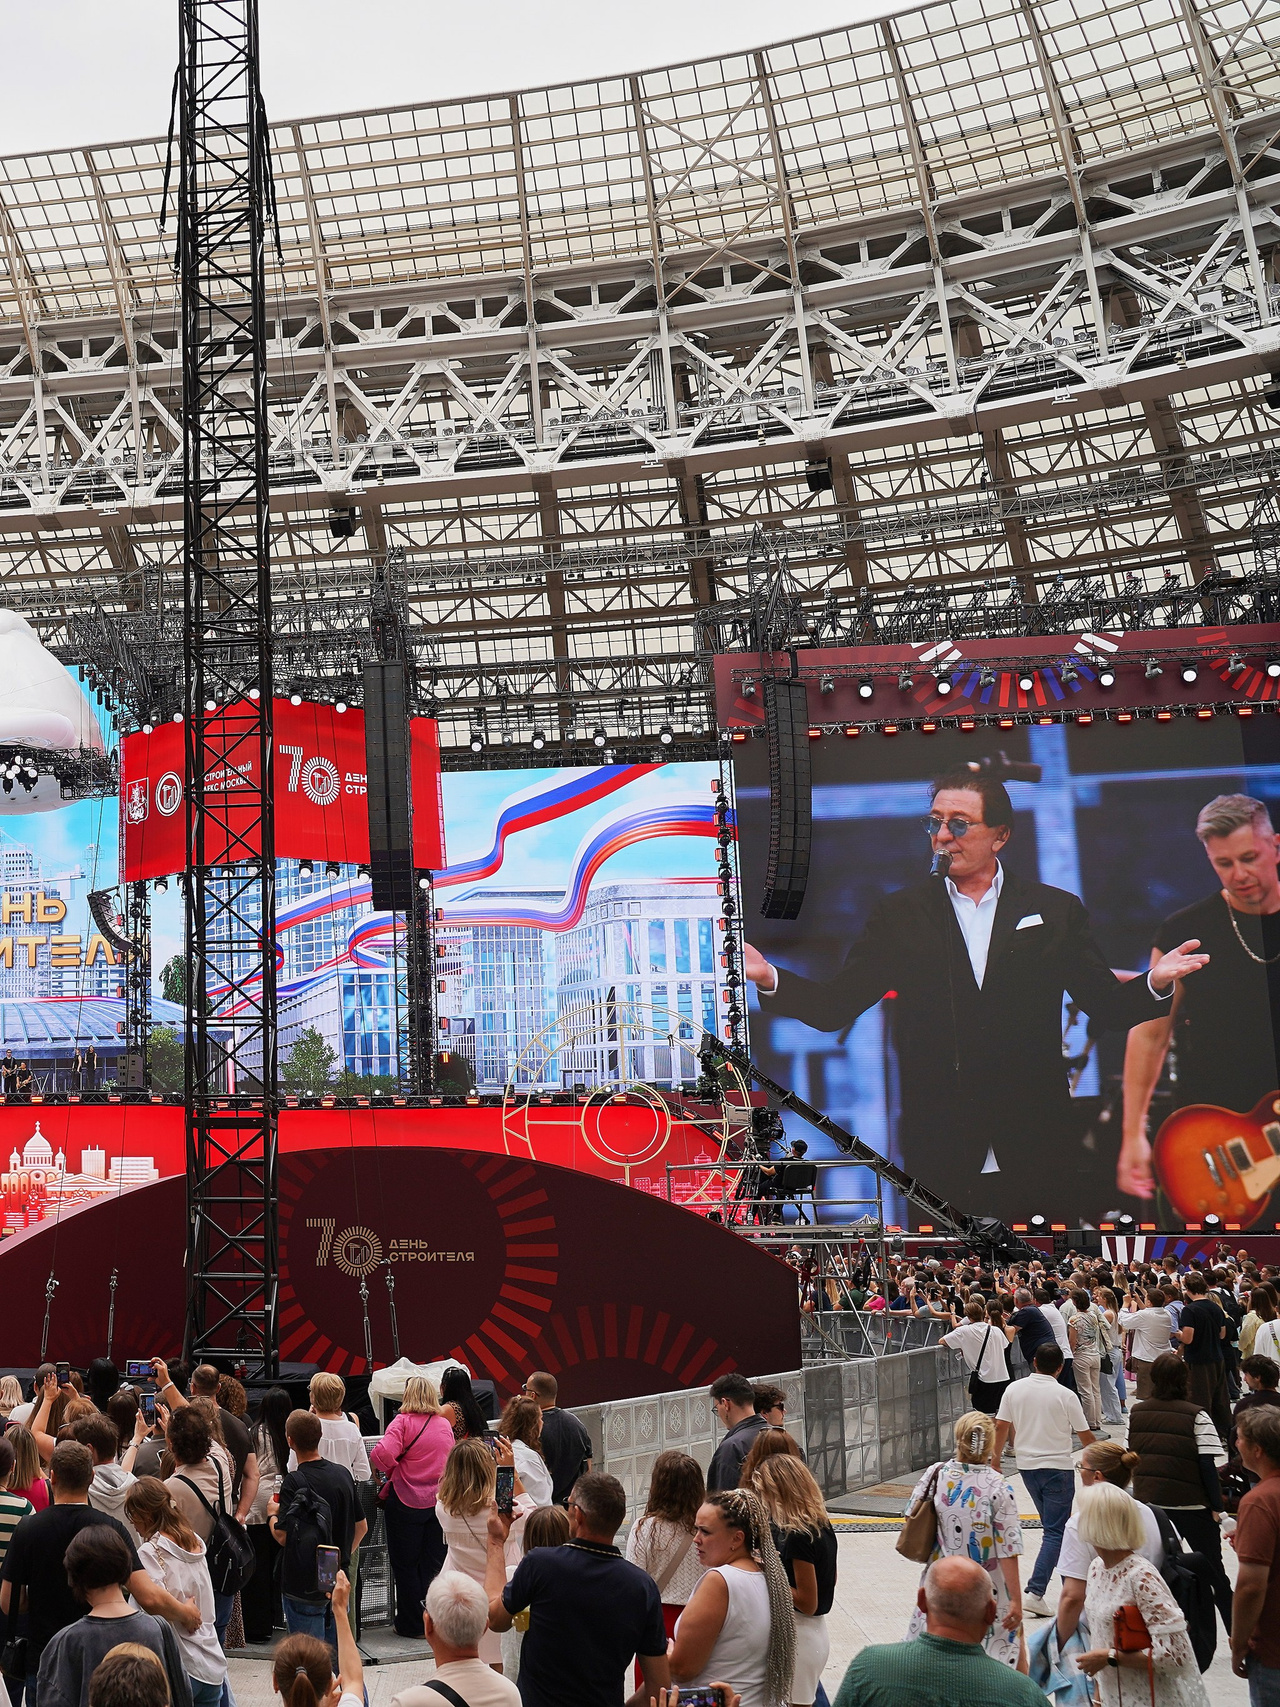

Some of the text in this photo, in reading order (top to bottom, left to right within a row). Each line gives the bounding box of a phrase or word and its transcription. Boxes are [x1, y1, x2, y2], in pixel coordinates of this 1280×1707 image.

[344, 772, 368, 784] ДЕН
[389, 1239, 428, 1249] ДЕНЬ
[389, 1252, 475, 1262] СТРОИТЕЛЯ
